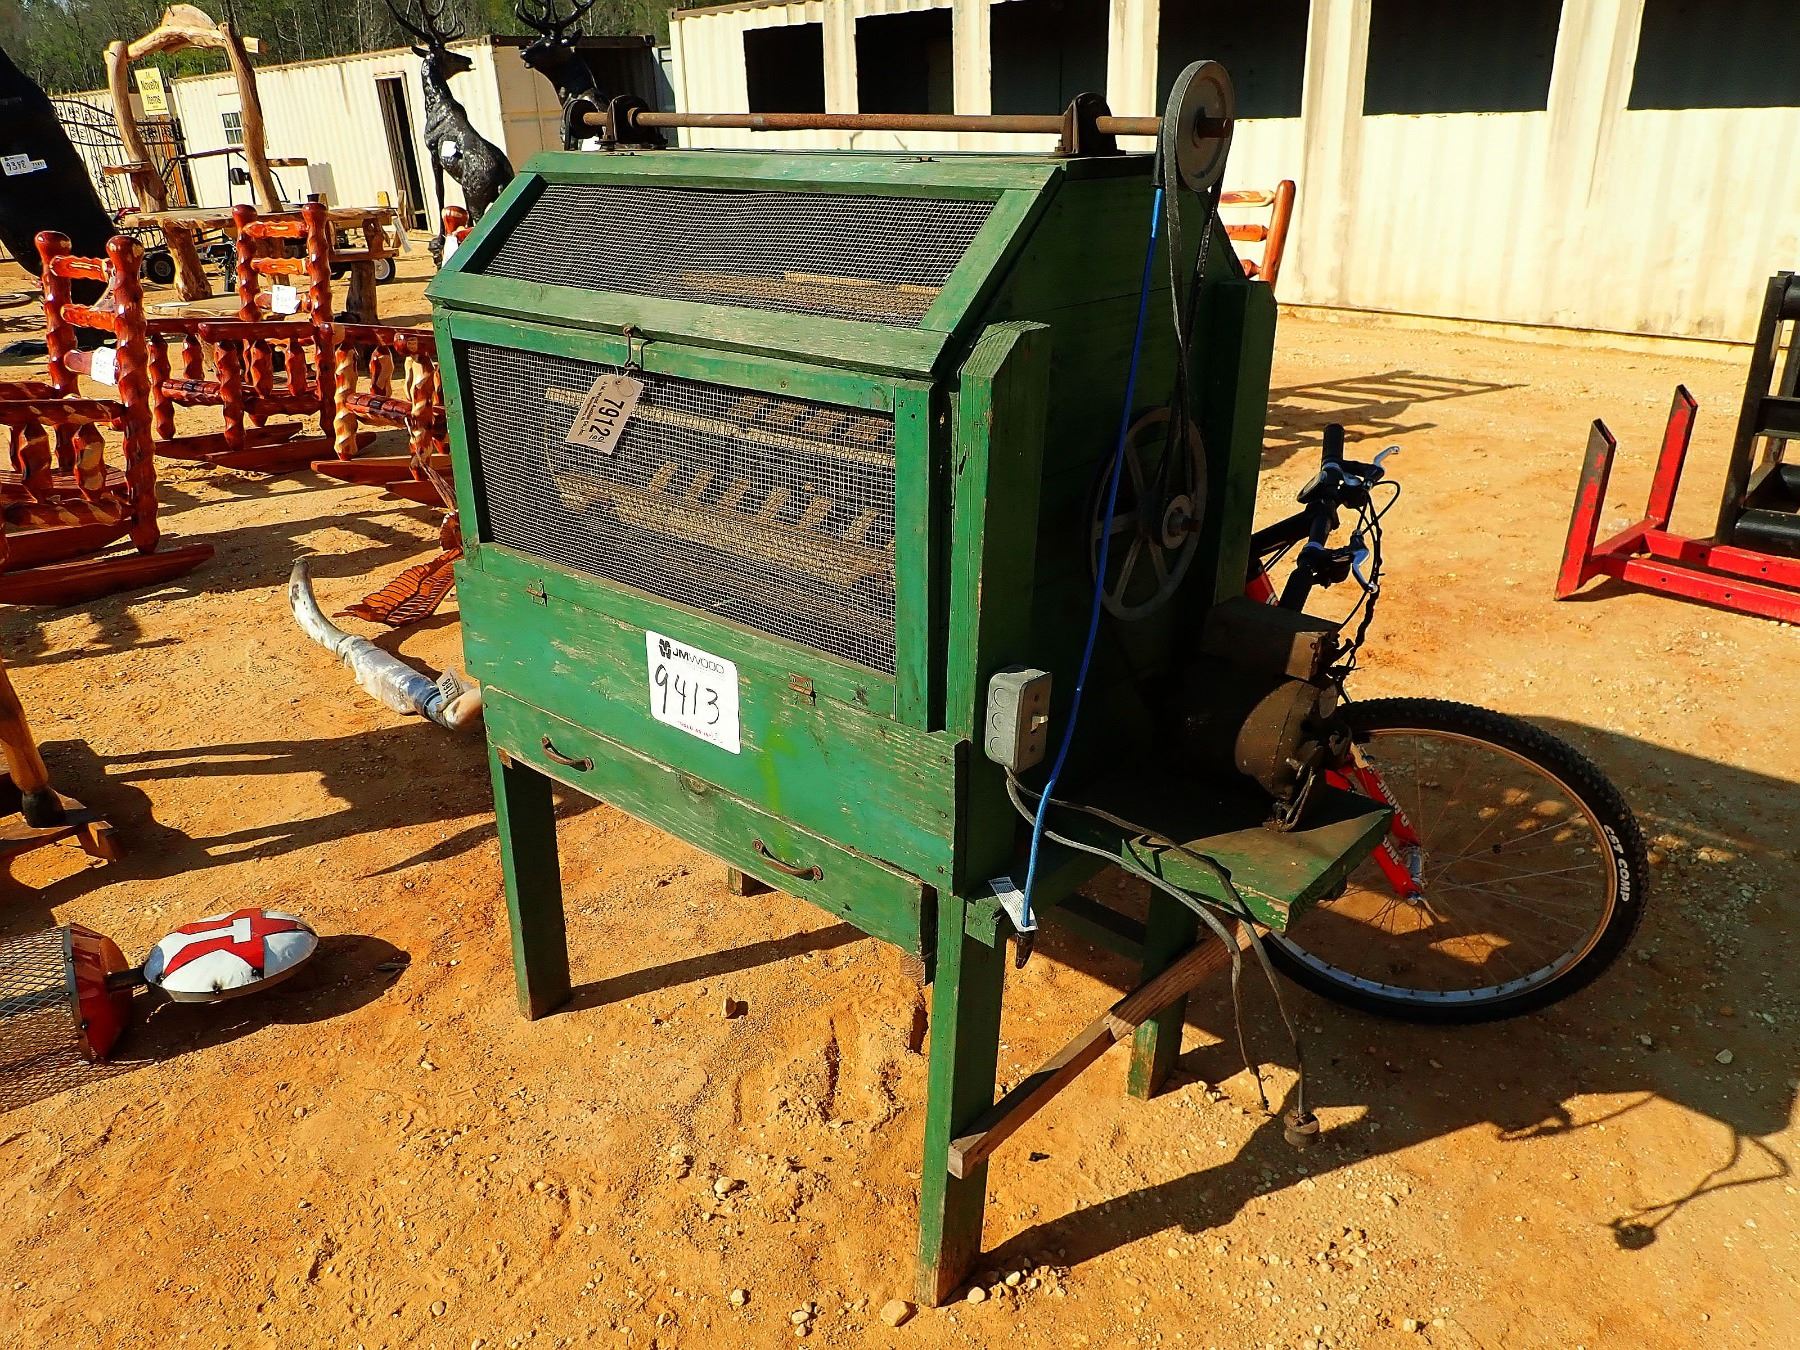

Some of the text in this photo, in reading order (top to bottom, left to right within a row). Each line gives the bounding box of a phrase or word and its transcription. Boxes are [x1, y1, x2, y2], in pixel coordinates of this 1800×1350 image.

[140, 79, 160, 91] Novelty
[146, 94, 161, 105] Items
[589, 398, 625, 437] 7912
[655, 663, 720, 725] 9413
[1603, 824, 1631, 902] CST COMP
